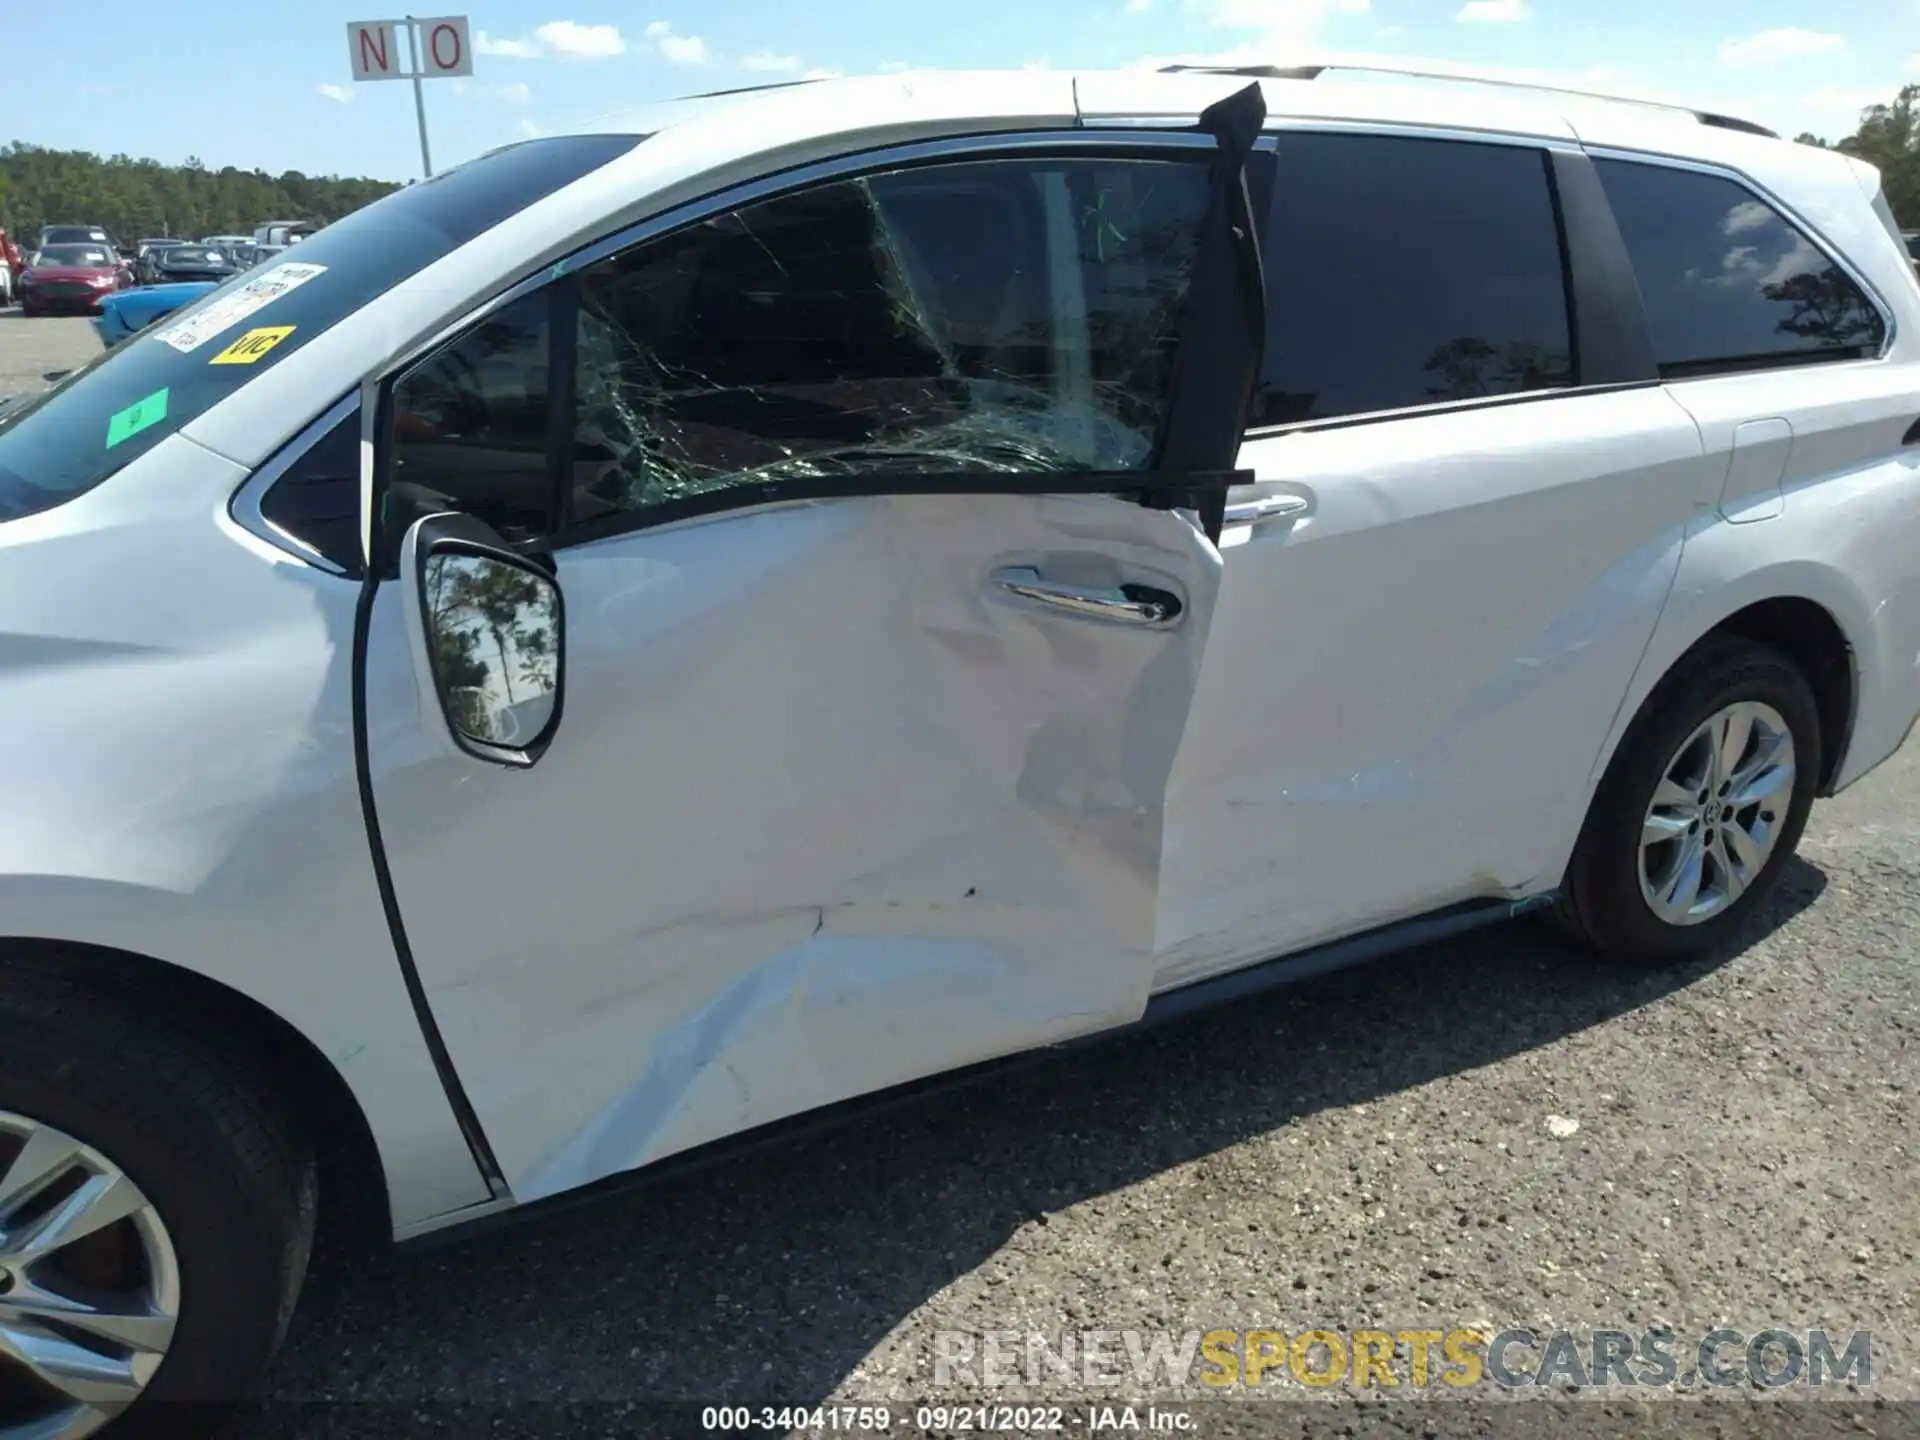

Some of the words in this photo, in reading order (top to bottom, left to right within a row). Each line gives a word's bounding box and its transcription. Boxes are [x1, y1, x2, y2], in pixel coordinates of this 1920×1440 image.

[359, 27, 388, 73] N
[431, 23, 461, 70] O
[227, 334, 280, 356] VIC
